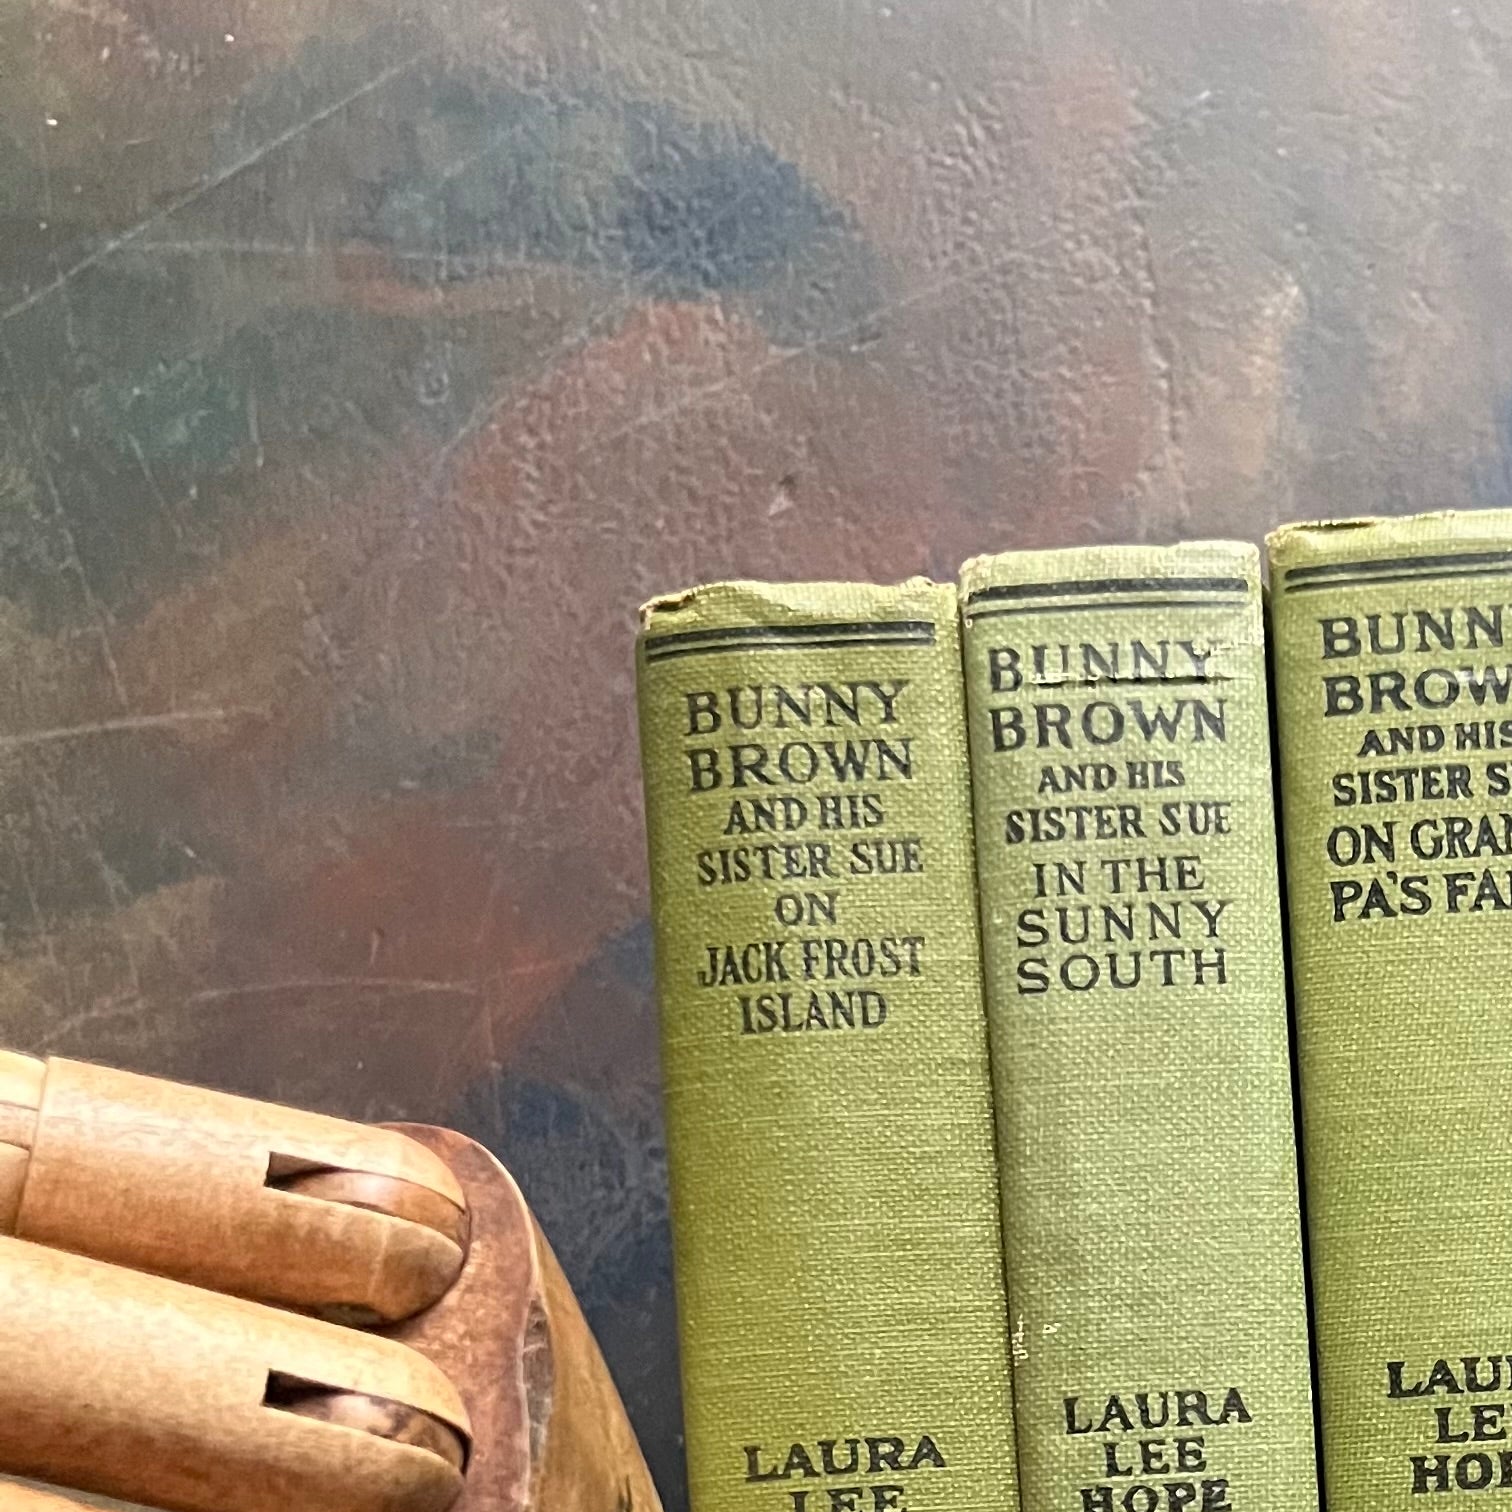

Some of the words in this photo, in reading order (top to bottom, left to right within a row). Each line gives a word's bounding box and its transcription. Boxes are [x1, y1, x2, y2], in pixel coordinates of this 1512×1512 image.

[989, 641, 1222, 693] BUNNY
[685, 679, 909, 737] BUNNY
[990, 698, 1229, 753] BROWN
[1357, 724, 1445, 757] AND
[687, 738, 914, 792] BROWN
[1038, 763, 1117, 793] AND
[1129, 759, 1185, 788] HIS
[1332, 764, 1472, 807] SISTER
[723, 796, 807, 836] AND
[819, 793, 885, 828] HIS
[1006, 806, 1146, 845] SISTER
[1160, 802, 1232, 836] SUE
[698, 843, 832, 887] SISTER
[851, 839, 923, 876] SUE
[1327, 821, 1396, 867] ON
[1034, 862, 1087, 898] IN
[1104, 855, 1205, 893] THE
[1330, 874, 1432, 922] PA'S
[774, 892, 839, 927] ON
[1016, 902, 1231, 949] SUNNY
[698, 941, 789, 989] JACK
[803, 937, 925, 981] FROST
[1017, 948, 1229, 996] SOUTH
[740, 990, 888, 1035] ISLAND
[1064, 1388, 1253, 1435] LAURA
[744, 1435, 947, 1483] LAURA
[1104, 1437, 1209, 1477] LEE
